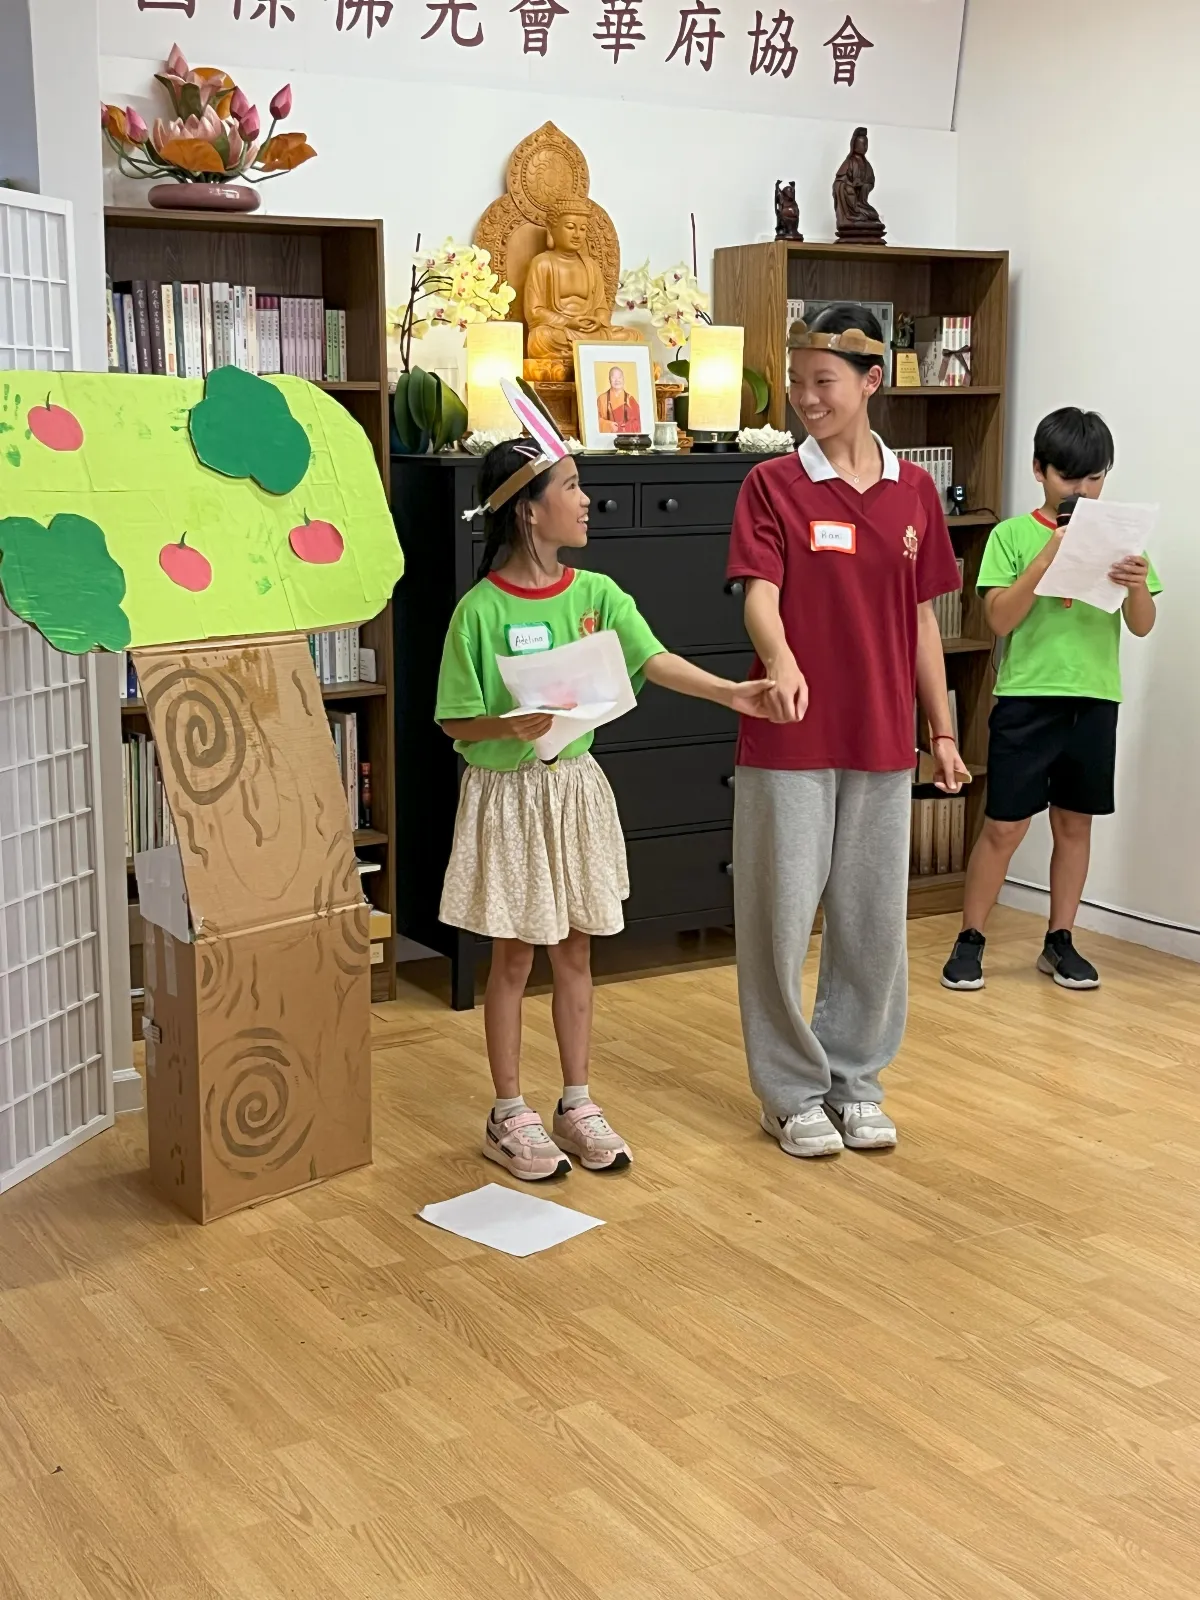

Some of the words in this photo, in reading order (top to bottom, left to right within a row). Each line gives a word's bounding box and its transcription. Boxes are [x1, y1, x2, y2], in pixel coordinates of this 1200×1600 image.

[138, 0, 874, 87] 佛光會華府協會
